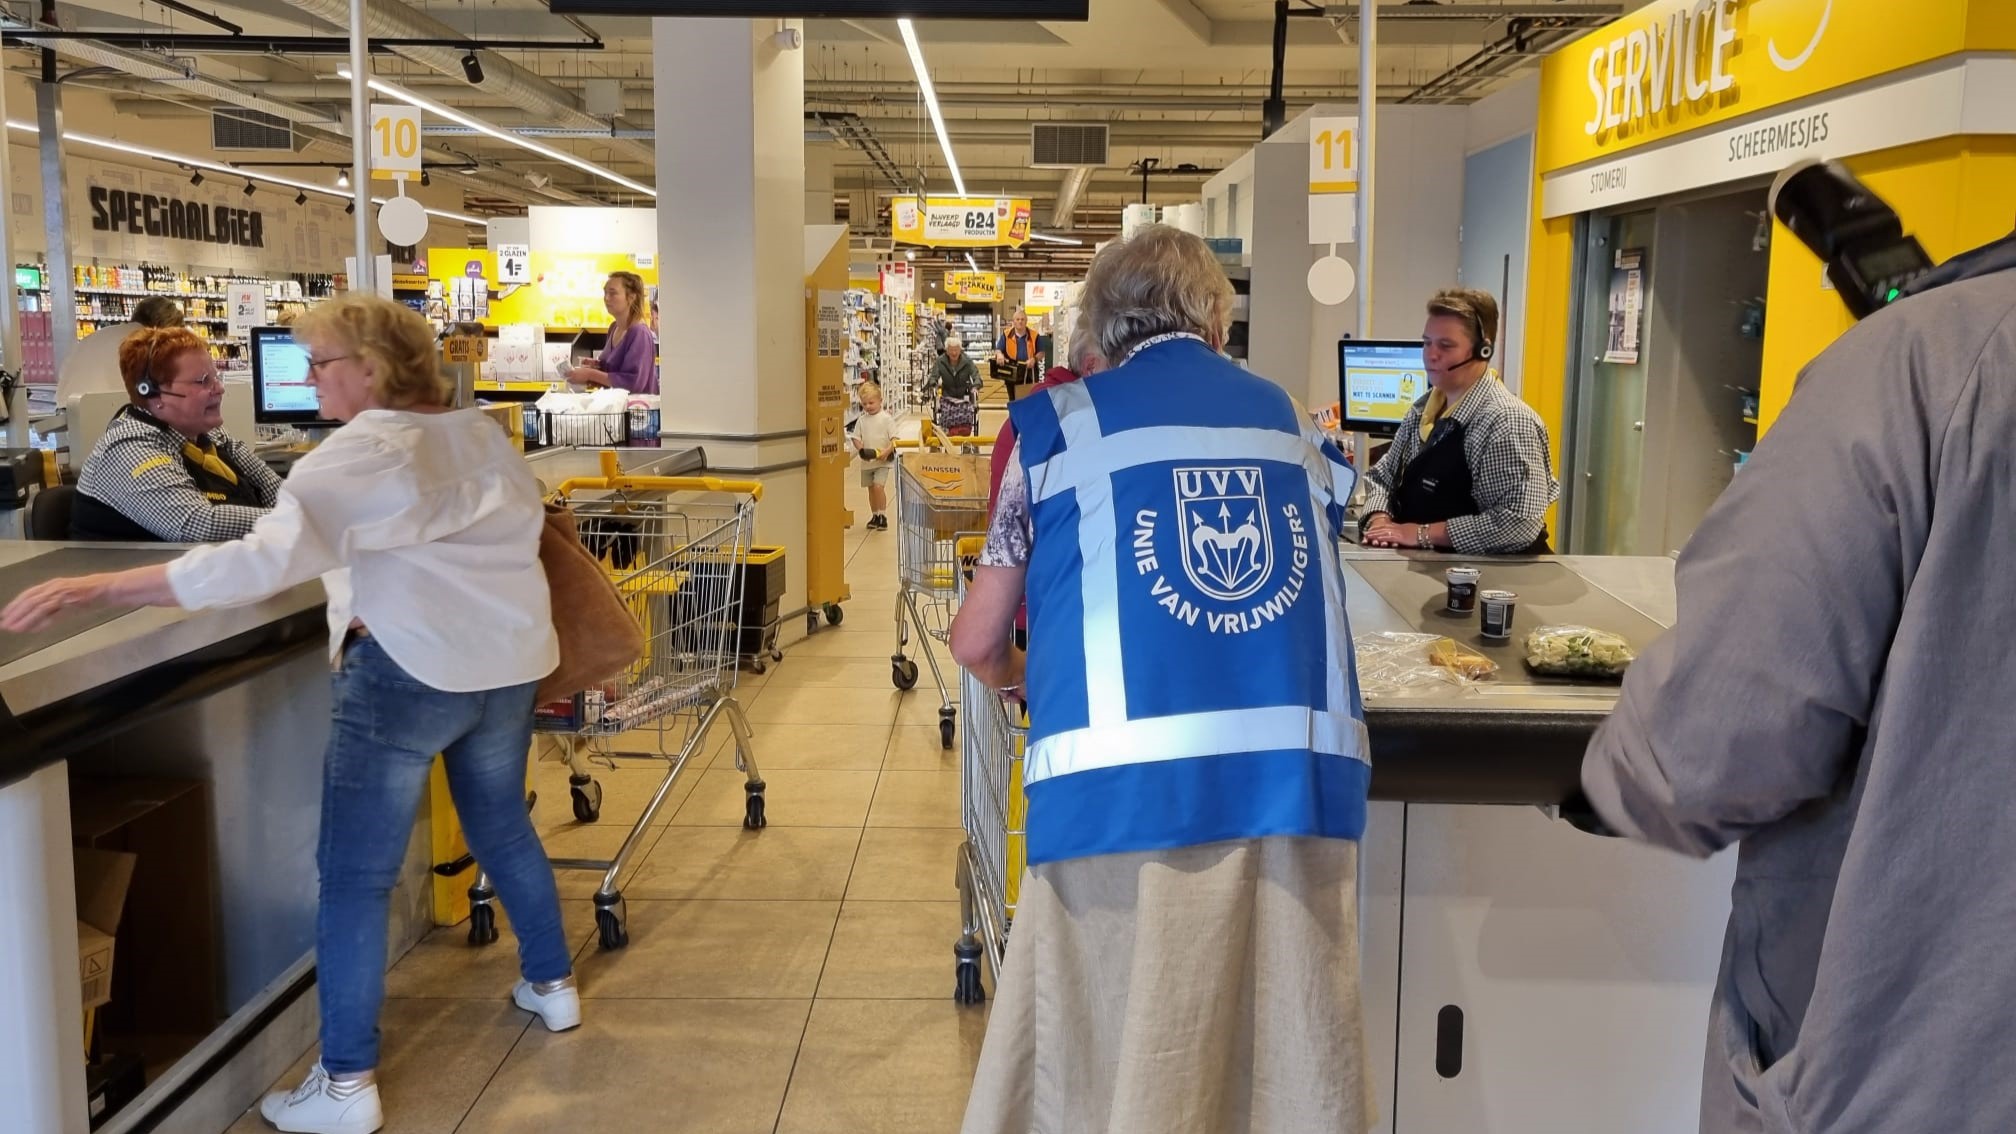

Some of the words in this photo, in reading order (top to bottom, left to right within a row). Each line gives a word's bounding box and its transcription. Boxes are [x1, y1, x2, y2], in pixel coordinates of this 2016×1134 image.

[1585, 0, 1736, 135] SERVICE
[374, 117, 417, 158] 10
[1315, 129, 1352, 170] 11
[1728, 112, 1829, 163] SCHEERMESJES
[1590, 166, 1627, 194] STOMERIJ
[965, 212, 995, 229] 624
[449, 340, 470, 354] GRATIS
[922, 465, 960, 473] HANSSEN
[1178, 471, 1259, 498] UVV
[1133, 509, 1159, 576] UNIE
[1151, 575, 1200, 627] VAN
[1206, 503, 1308, 634] VRIJWILLIGERS
